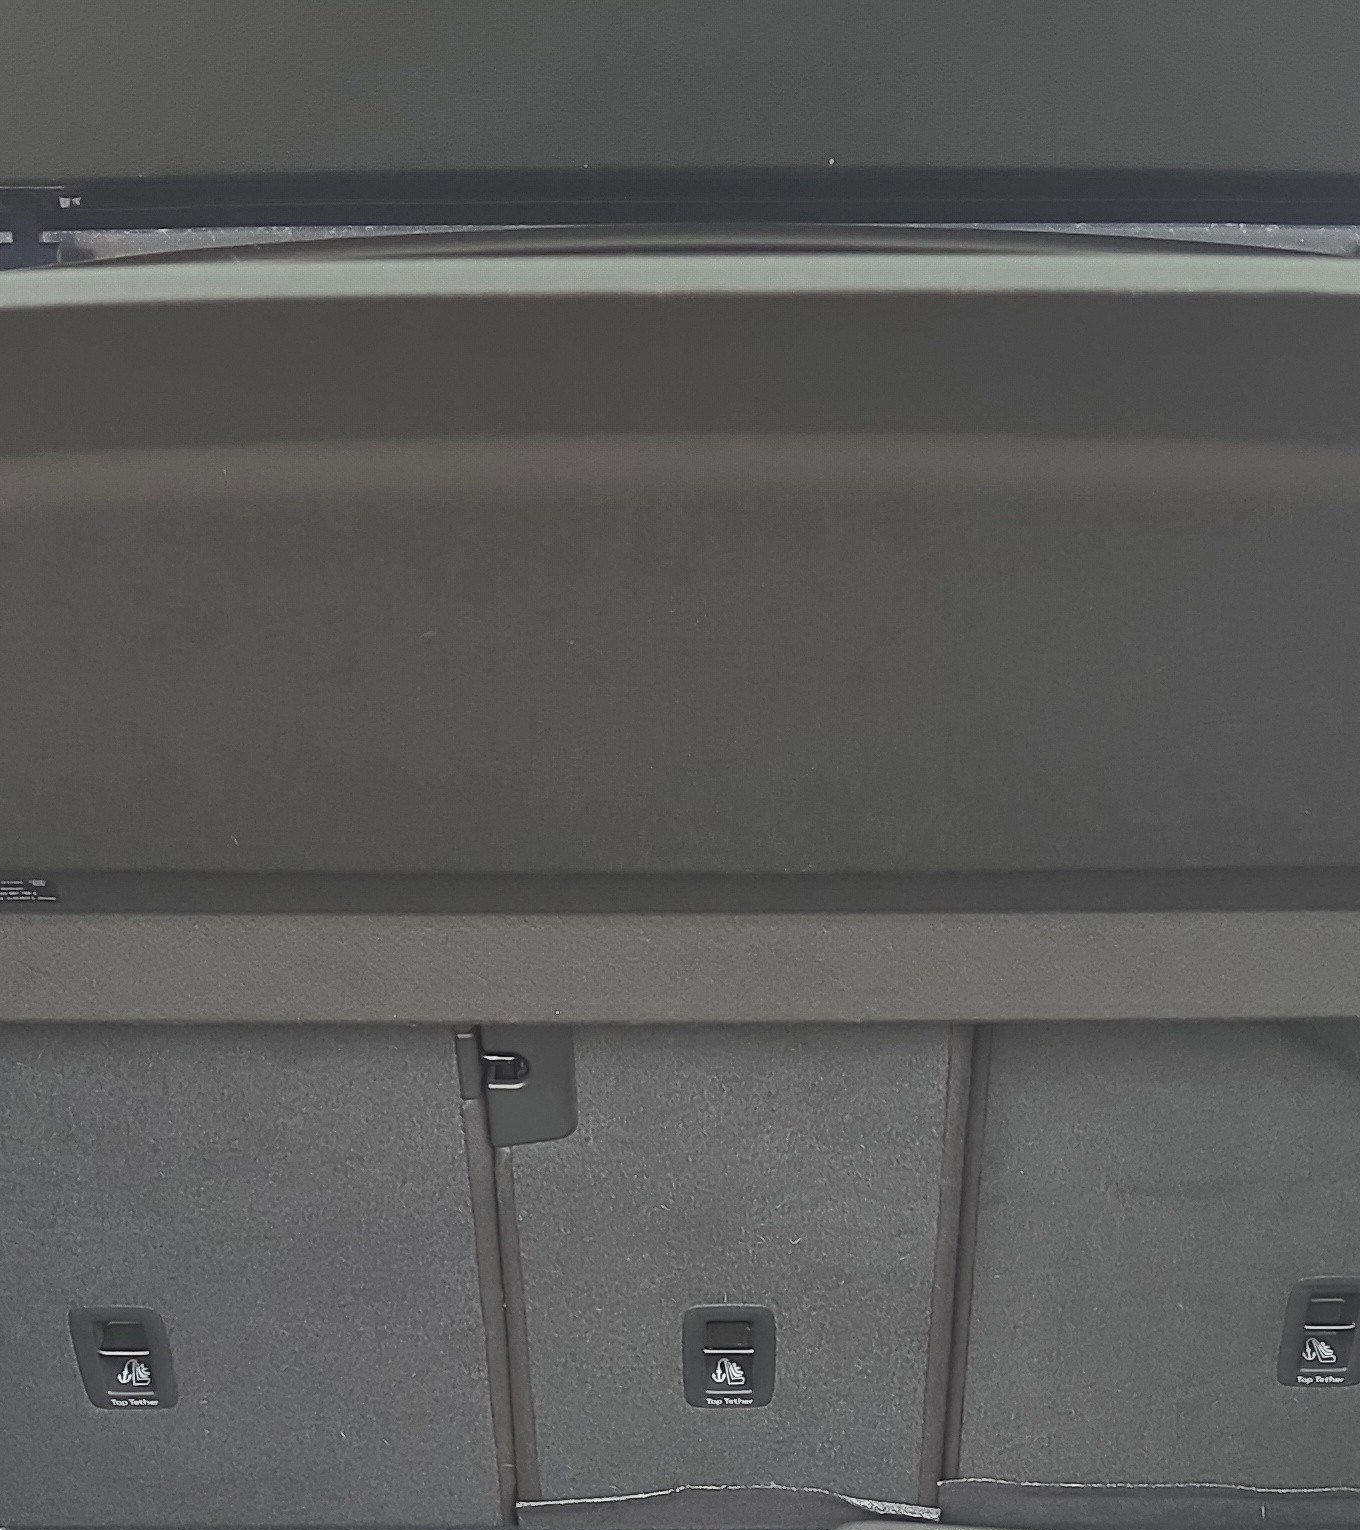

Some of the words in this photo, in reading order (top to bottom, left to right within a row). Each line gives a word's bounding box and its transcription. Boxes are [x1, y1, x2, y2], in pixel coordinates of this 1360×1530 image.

[1296, 1375, 1314, 1385] Top
[110, 1398, 128, 1407] Top
[706, 1397, 723, 1406] Top
